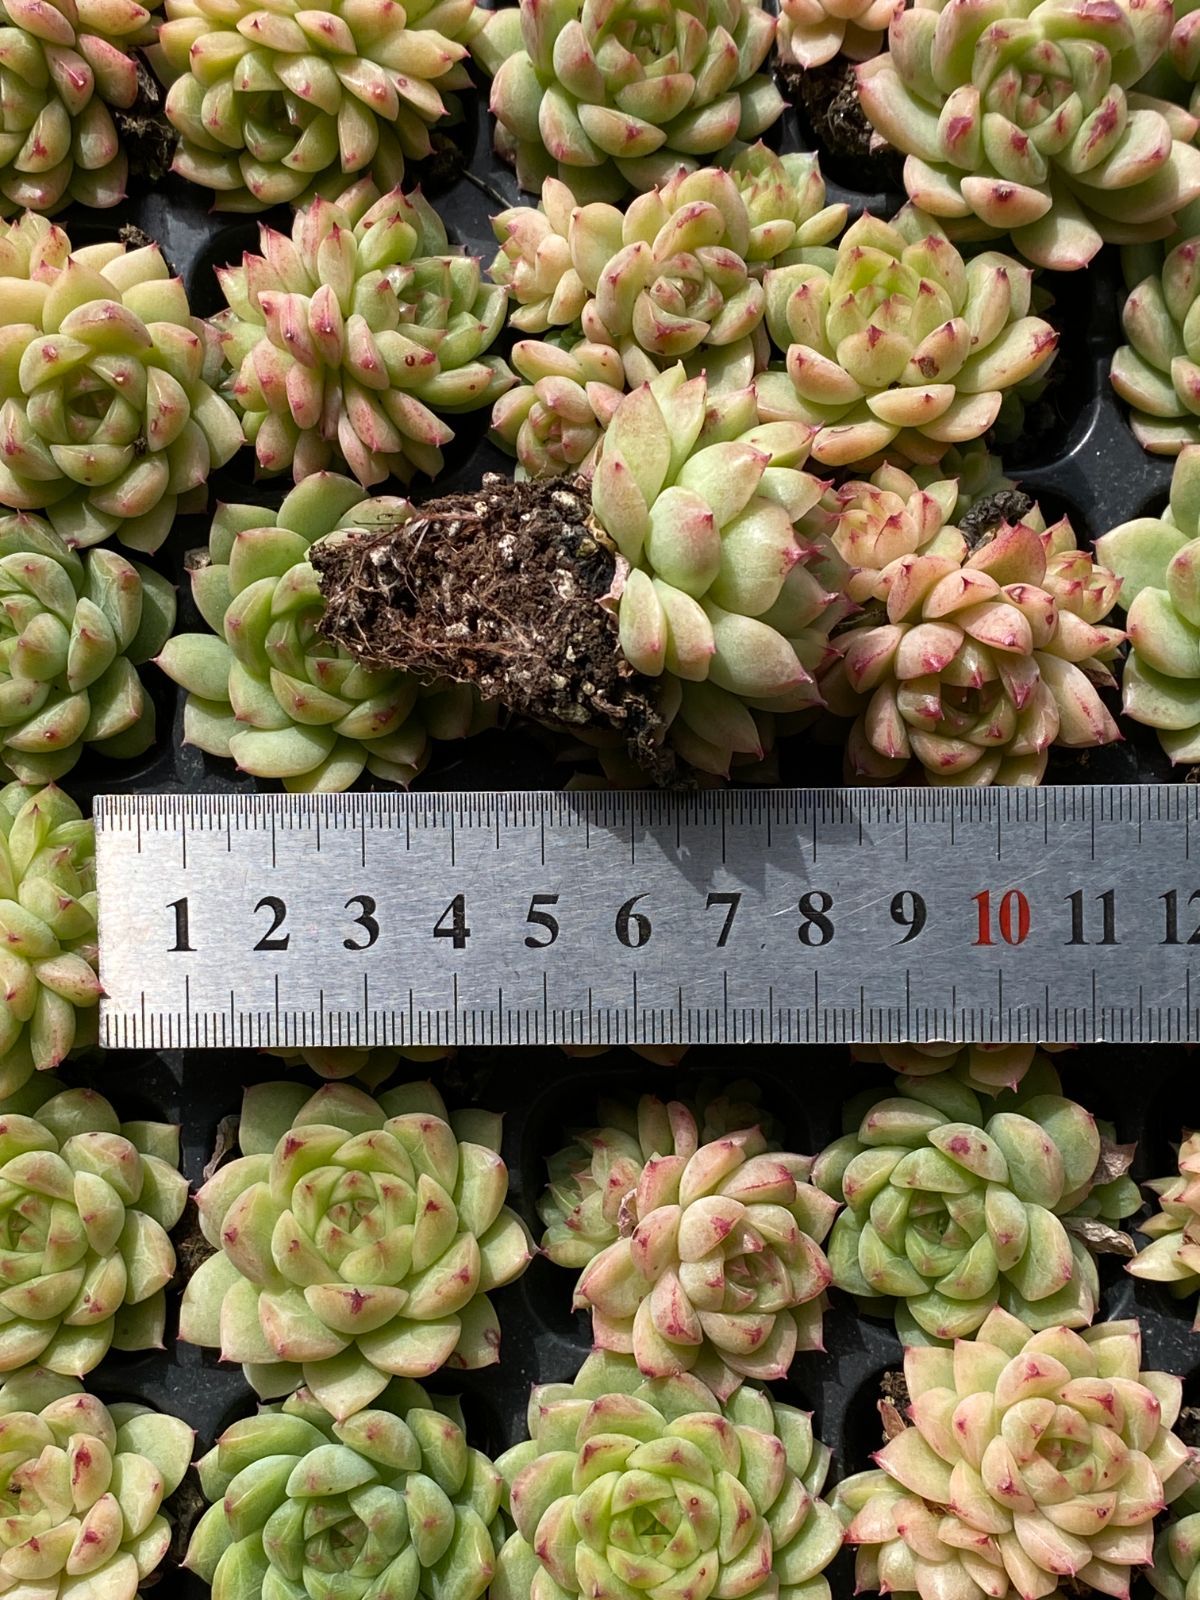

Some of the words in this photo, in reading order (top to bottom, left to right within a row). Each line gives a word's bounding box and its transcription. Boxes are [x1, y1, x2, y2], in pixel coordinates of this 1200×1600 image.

[166, 897, 197, 952] 1
[253, 896, 290, 951] 2
[343, 895, 380, 950] 3
[433, 894, 471, 949] 4
[524, 893, 560, 949] 5
[614, 892, 652, 948] 6
[704, 892, 742, 947] 7
[797, 890, 835, 947] 8
[889, 890, 928, 946] 9
[970, 889, 1031, 946] 10
[1063, 888, 1122, 946] 11
